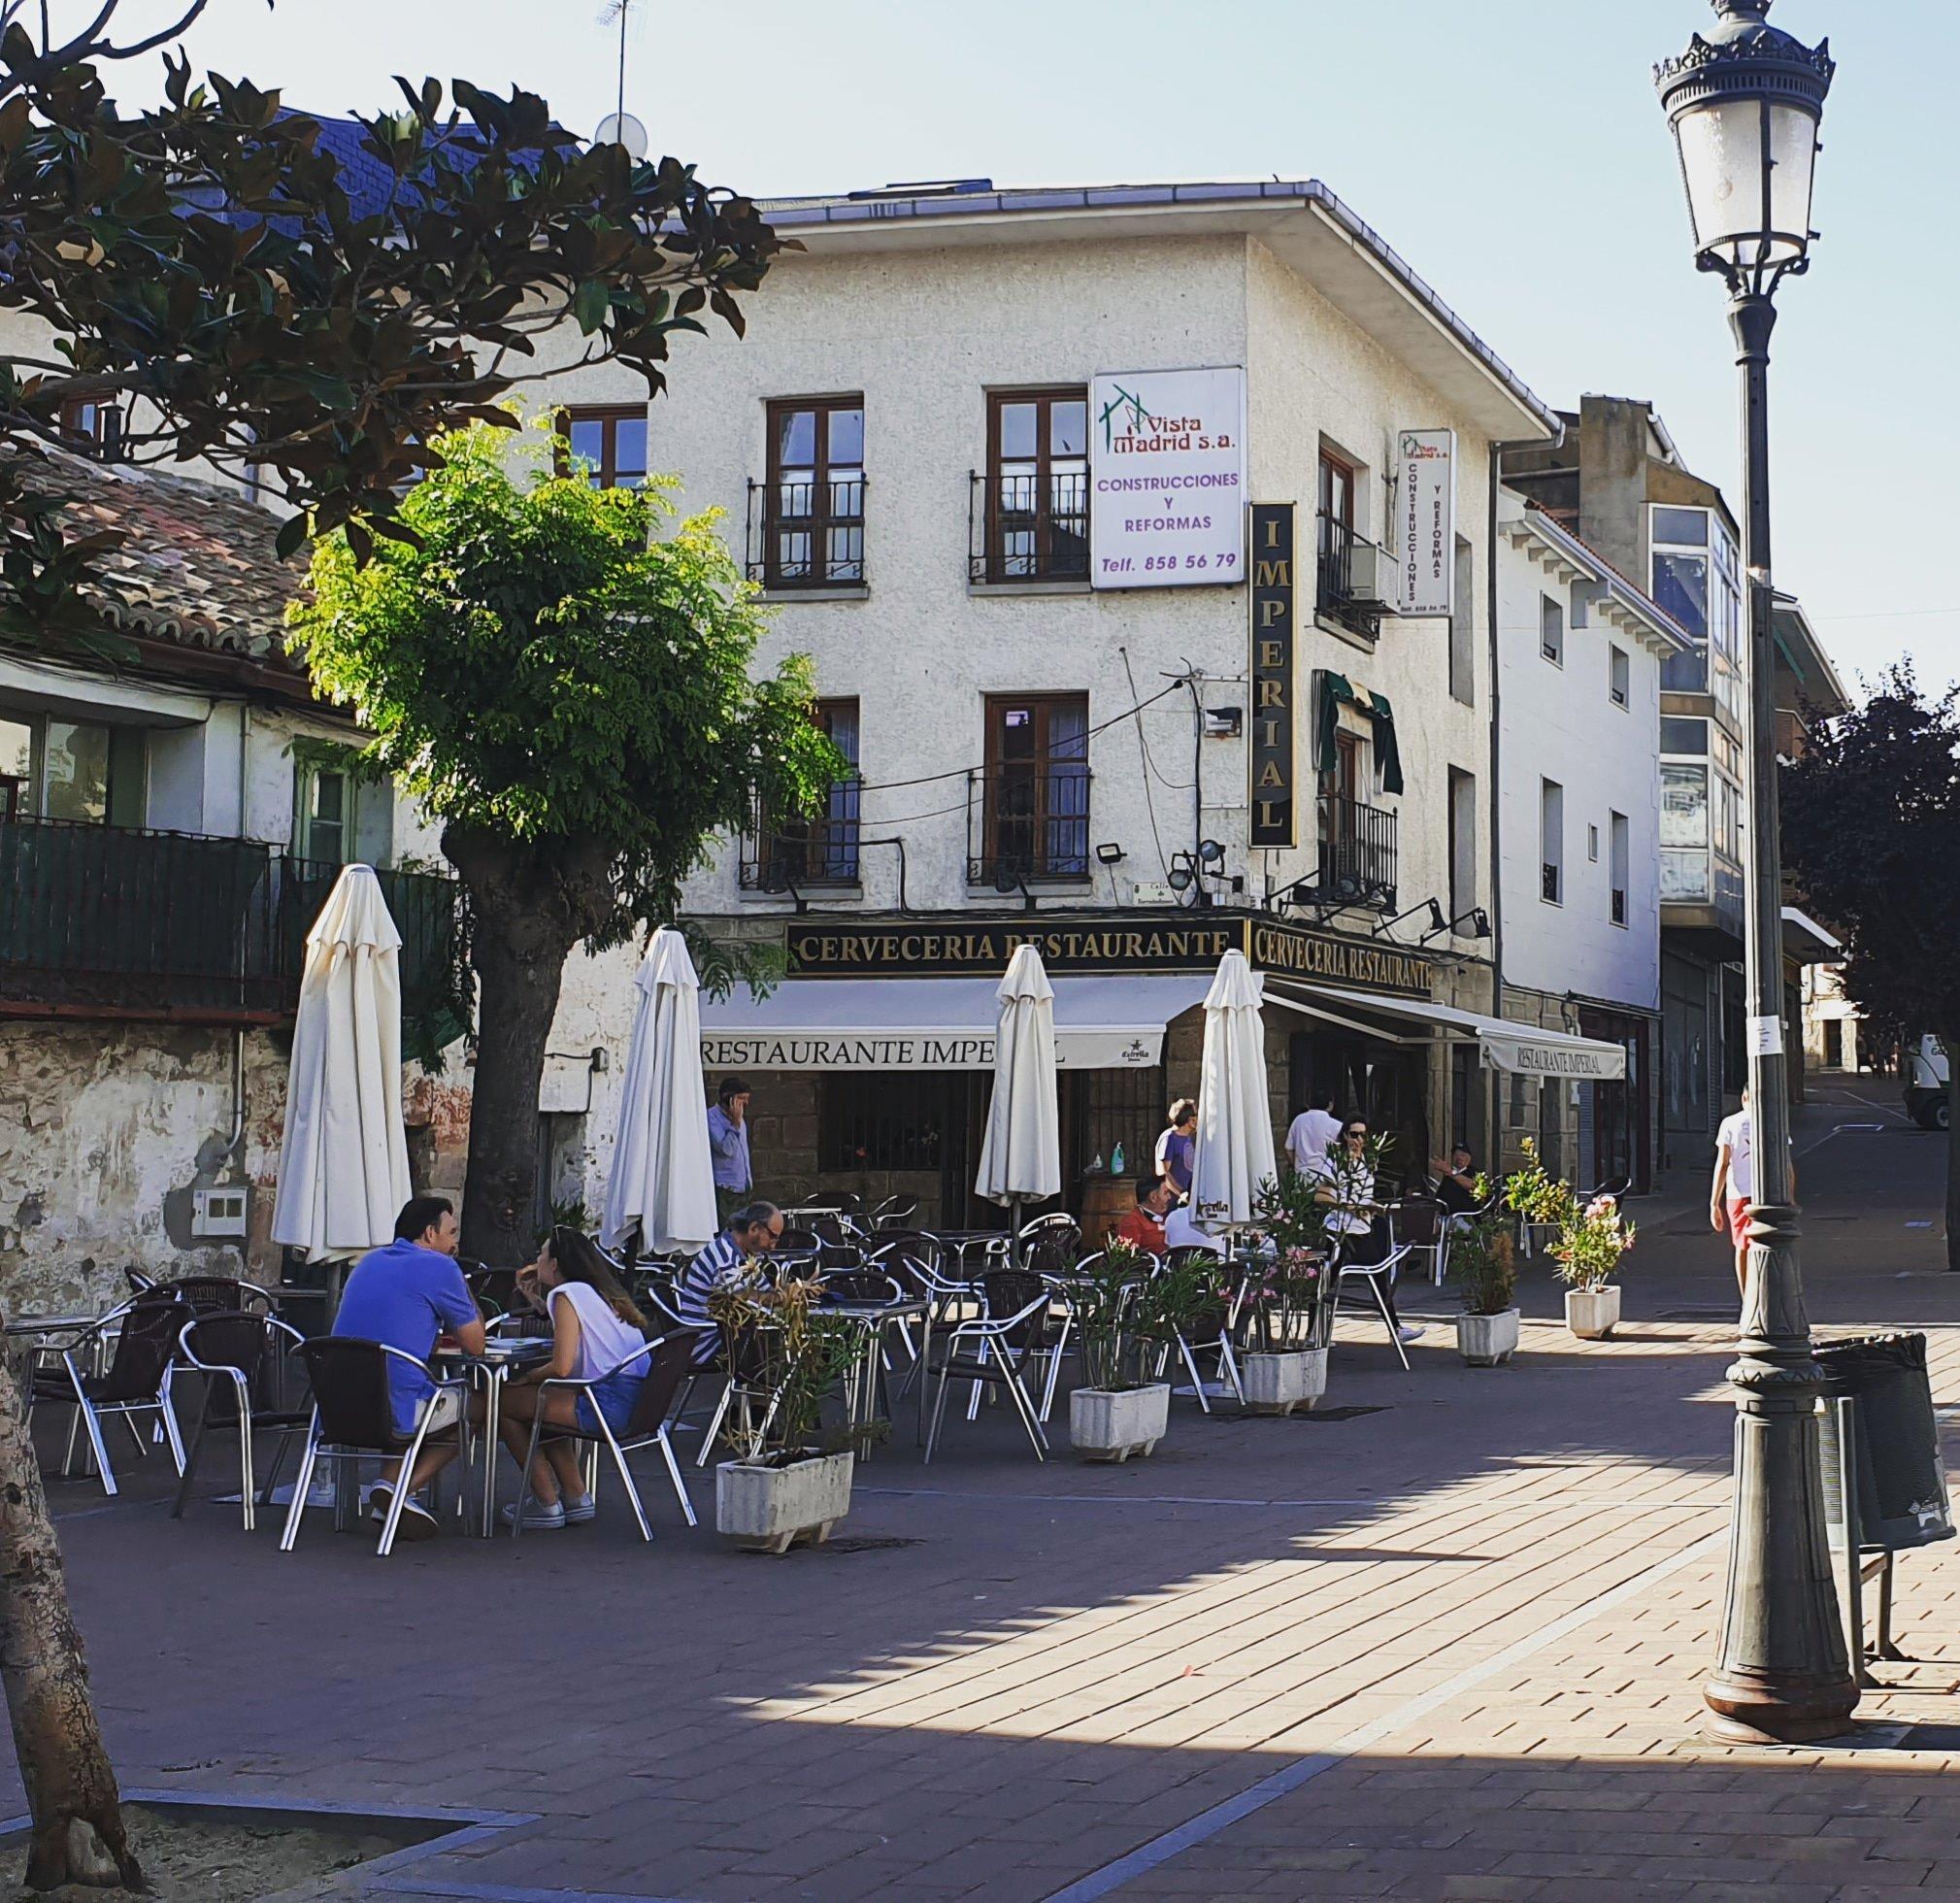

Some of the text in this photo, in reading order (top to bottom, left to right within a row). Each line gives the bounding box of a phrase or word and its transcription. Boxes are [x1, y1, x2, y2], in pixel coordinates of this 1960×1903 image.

[1147, 417, 1202, 433] Vista
[1113, 433, 1191, 453] Madrid
[1097, 473, 1239, 492] CONSTRUCCIONES
[1164, 497, 1174, 510] Y
[1124, 516, 1212, 532] REFORMAS
[1408, 463, 1417, 602] CONSTRUCCIONES
[1432, 484, 1443, 579] Y REFORMAS
[1102, 552, 1237, 573] Telf. 858 56 79
[1253, 520, 1291, 827] IMPERIAL
[797, 930, 1230, 962] CERVECERIA RESTAURANTE
[1255, 928, 1347, 978] CERVECERIA
[700, 1040, 914, 1064] RESTAURANTE
[1517, 1047, 1602, 1074] RESTAURANTE IMPERIAL
